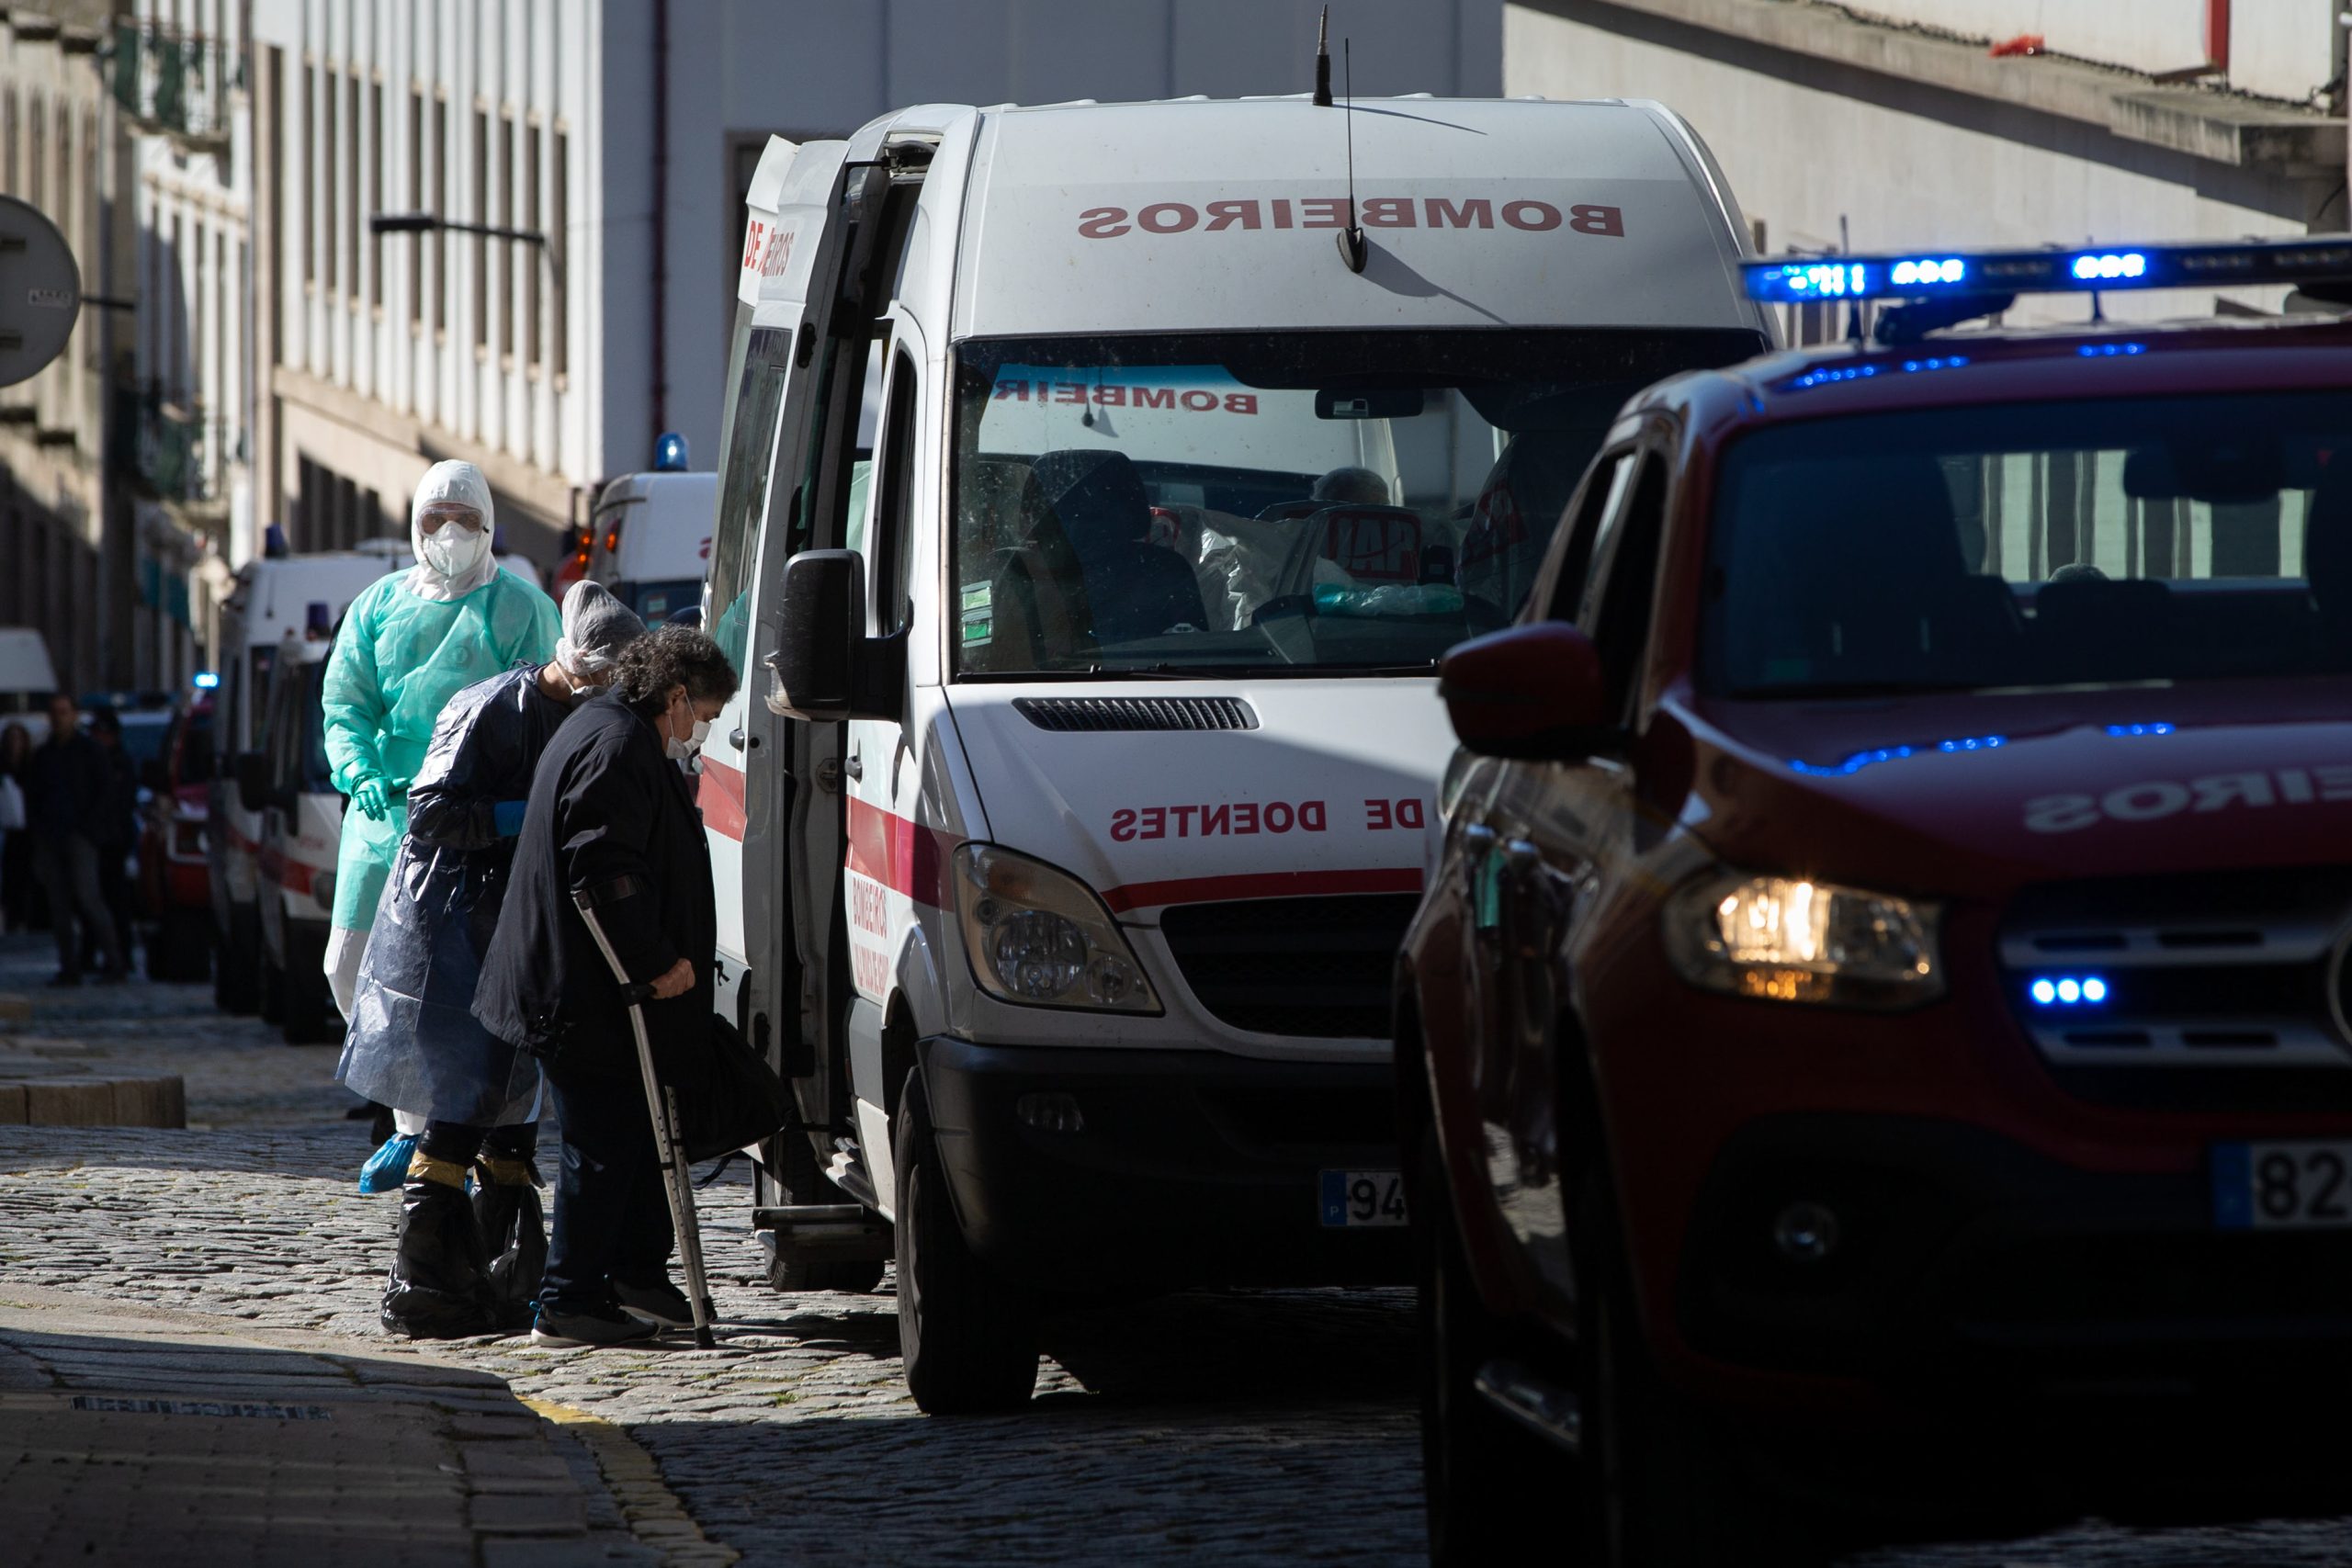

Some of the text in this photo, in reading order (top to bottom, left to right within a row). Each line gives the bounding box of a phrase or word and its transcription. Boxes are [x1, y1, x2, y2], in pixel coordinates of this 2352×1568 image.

[744, 220, 763, 269] DE
[1351, 1179, 1405, 1222] 94
[2257, 1151, 2347, 1220] 82
